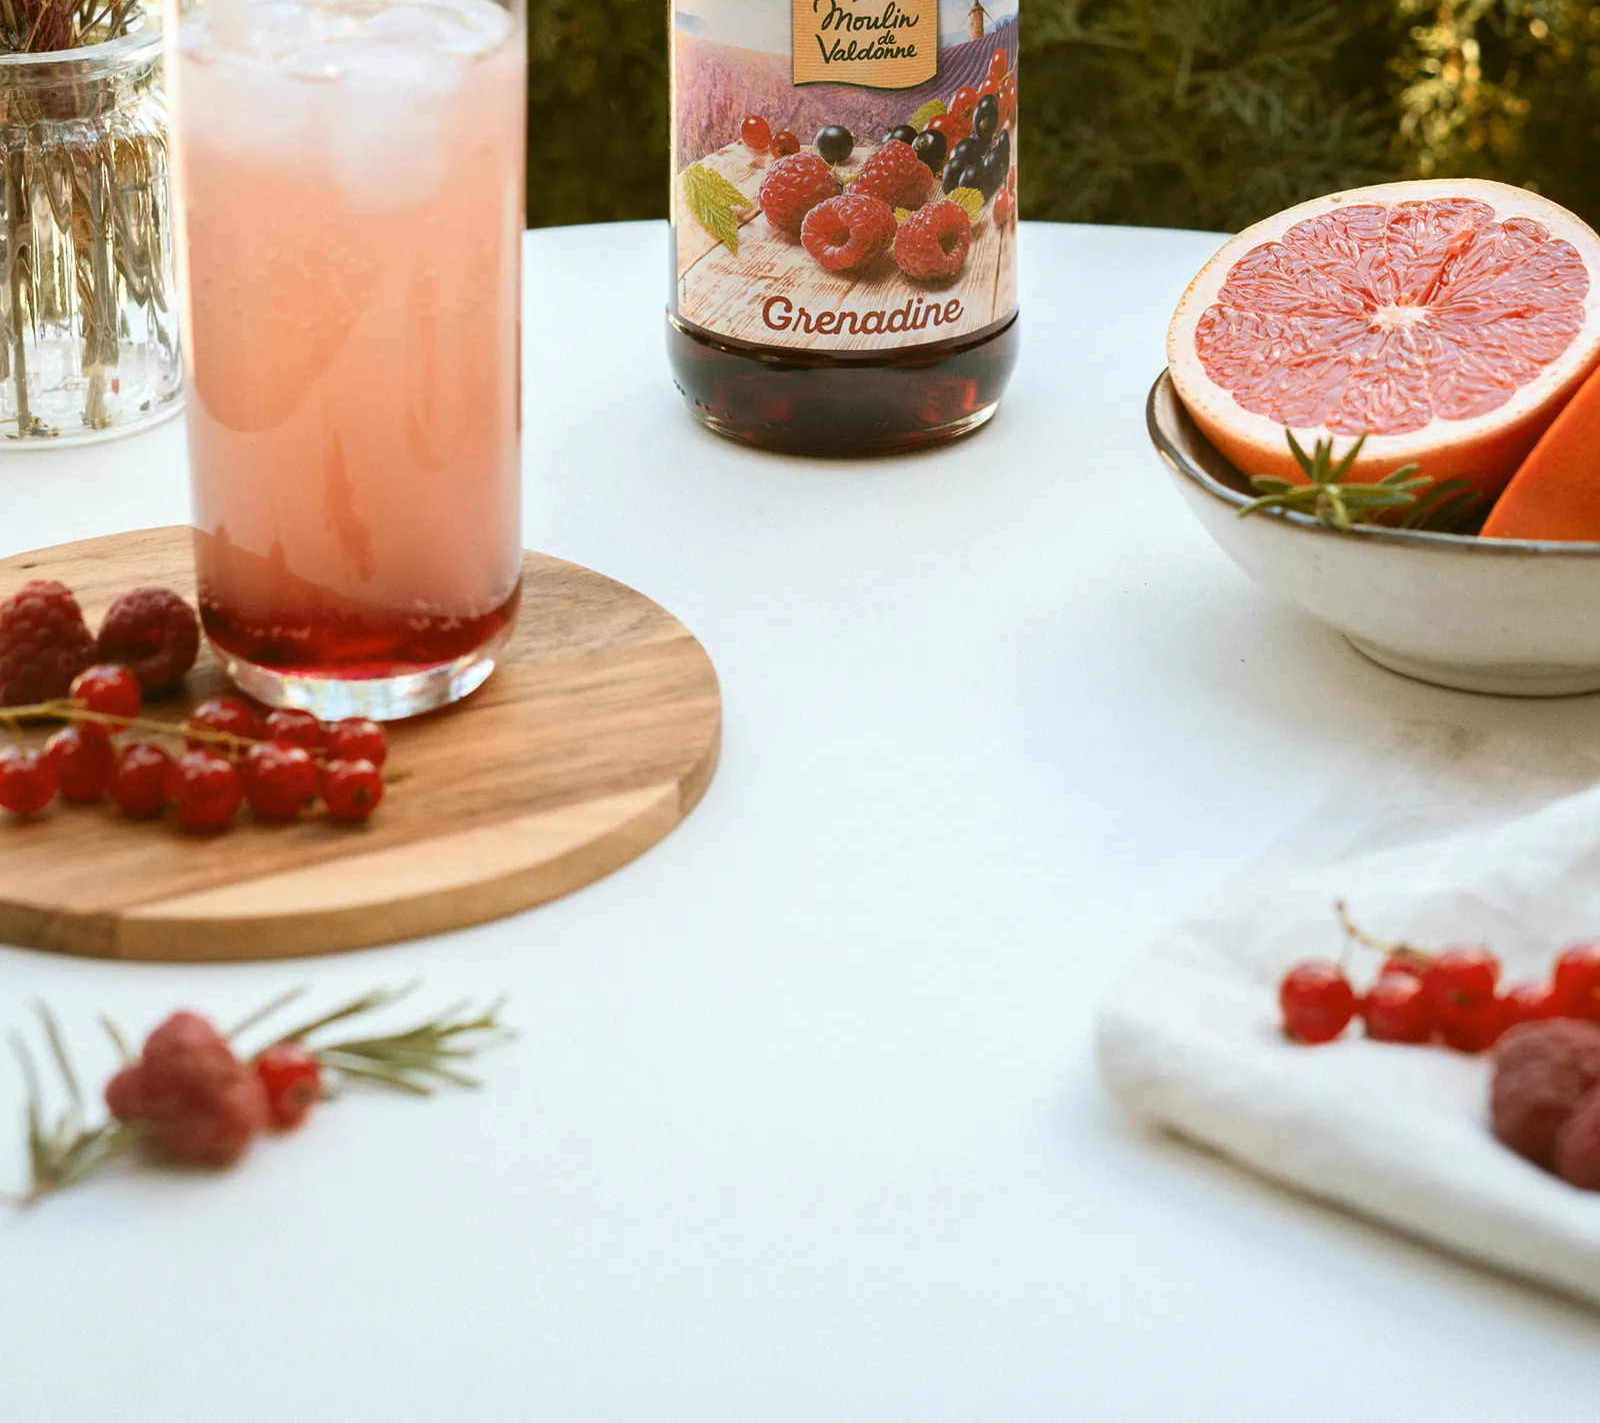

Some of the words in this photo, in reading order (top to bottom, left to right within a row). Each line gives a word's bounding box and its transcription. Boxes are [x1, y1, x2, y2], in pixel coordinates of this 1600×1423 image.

[815, 34, 918, 64] Valdonne
[877, 30, 897, 45] de
[762, 296, 964, 334] Grenadine
